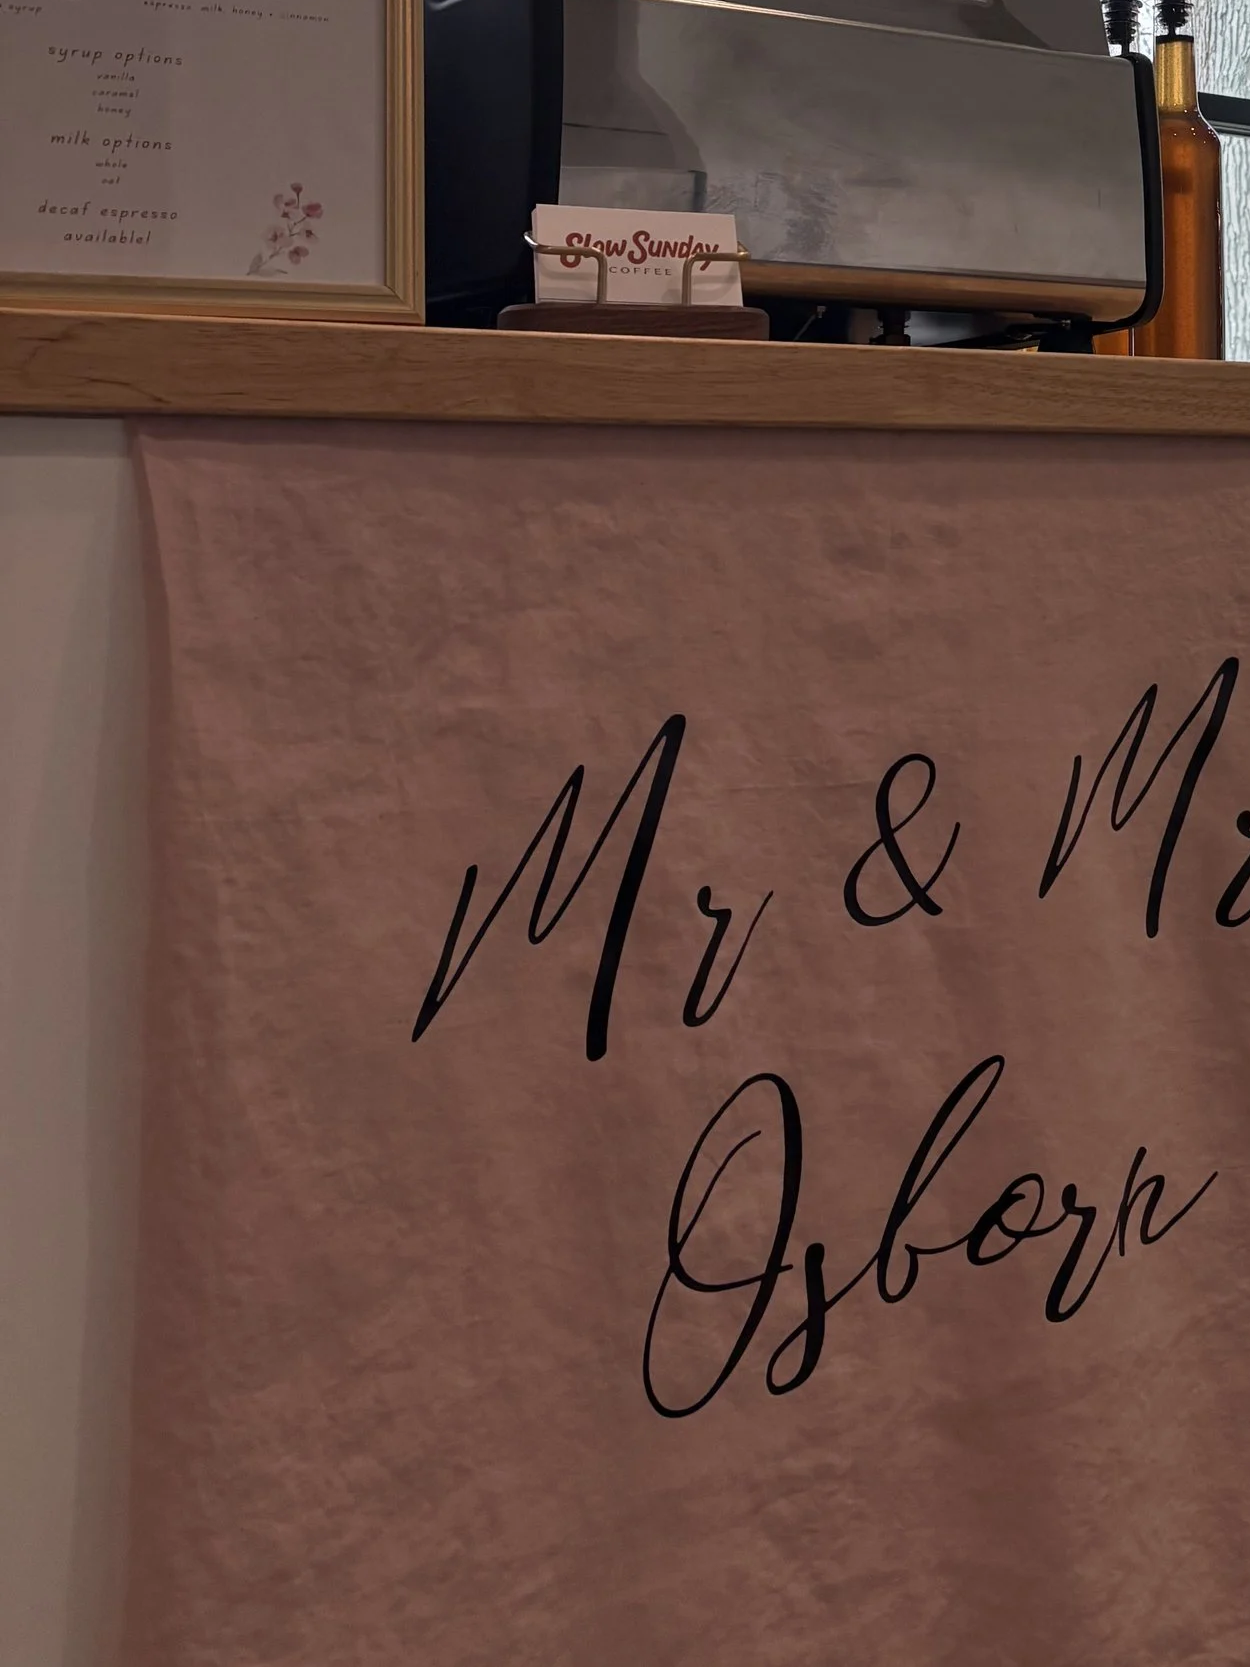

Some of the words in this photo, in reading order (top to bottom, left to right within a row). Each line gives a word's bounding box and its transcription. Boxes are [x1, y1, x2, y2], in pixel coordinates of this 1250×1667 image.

[232, 5, 263, 18] honey
[48, 45, 103, 66] syrup
[114, 47, 183, 67] options
[97, 72, 135, 82] vanilla
[92, 89, 139, 98] caramel
[97, 103, 131, 118] honey
[51, 130, 90, 145] milk
[102, 133, 172, 153] options
[95, 158, 128, 168] whole
[38, 200, 91, 216] decaf
[100, 207, 178, 223] espresso
[559, 232, 627, 269] Slow
[627, 230, 719, 271] Sunday
[608, 266, 672, 276] COFFEE
[412, 714, 774, 1061] Mr
[843, 753, 960, 926] &
[642, 1054, 1219, 1418] Osborn
